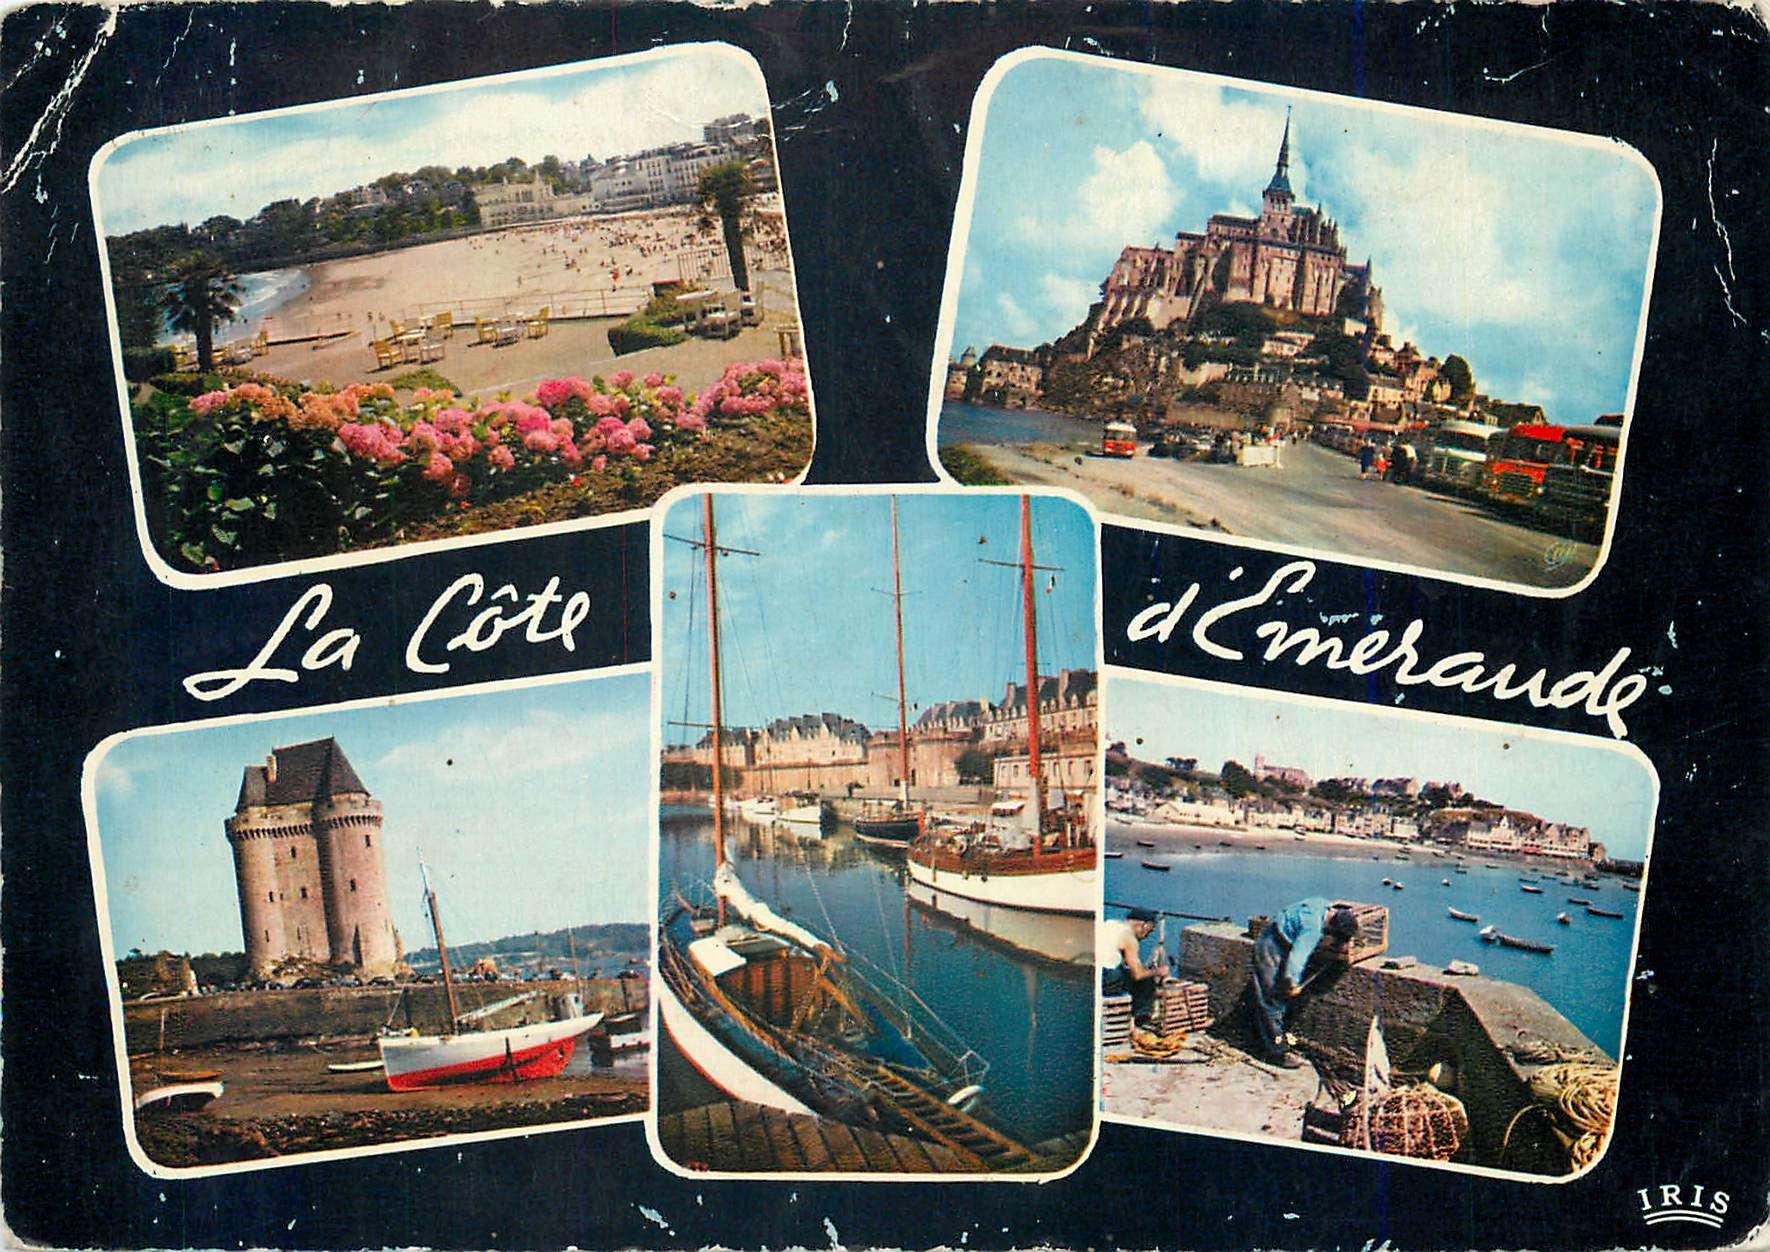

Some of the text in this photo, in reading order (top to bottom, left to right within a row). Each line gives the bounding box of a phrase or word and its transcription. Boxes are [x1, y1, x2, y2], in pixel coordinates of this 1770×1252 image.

[182, 583, 361, 702] La
[406, 572, 591, 675] Côte
[1637, 1184, 1730, 1214] IRIS
